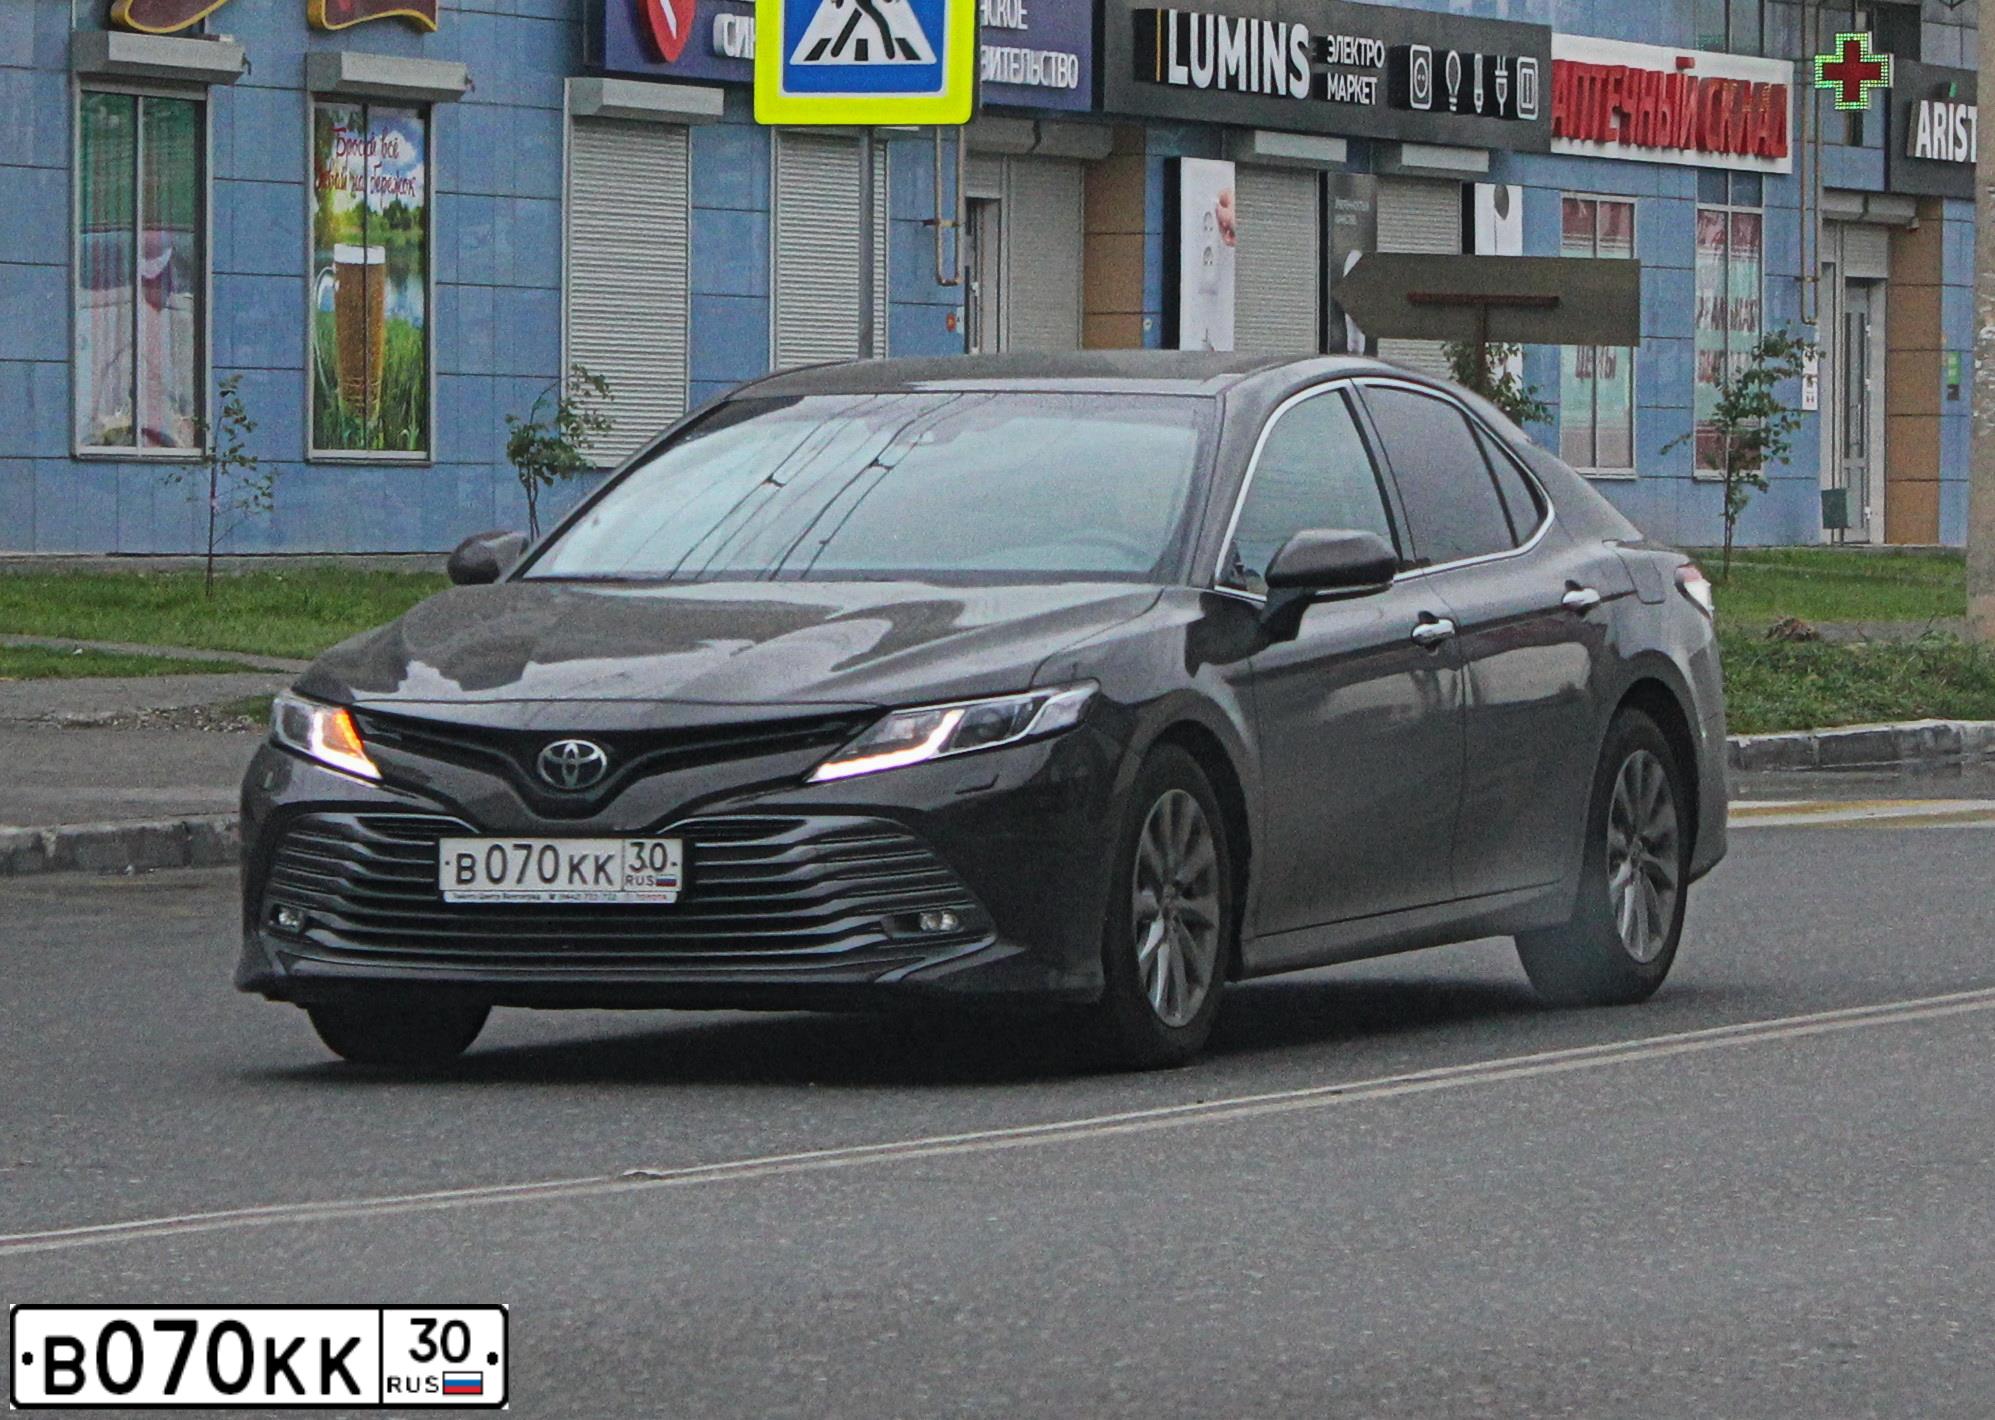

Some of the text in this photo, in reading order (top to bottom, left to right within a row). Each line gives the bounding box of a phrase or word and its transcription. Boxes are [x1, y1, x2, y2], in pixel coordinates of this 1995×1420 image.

[1168, 9, 1311, 100] LUMINS
[1327, 35, 1386, 69] ЭЛЕКТРО
[1327, 73, 1378, 106] МАРКЕТ
[1551, 56, 1788, 158] АПТЕЧНЫЙ СКЛАД
[629, 841, 668, 873] 30
[625, 875, 654, 887] RUS
